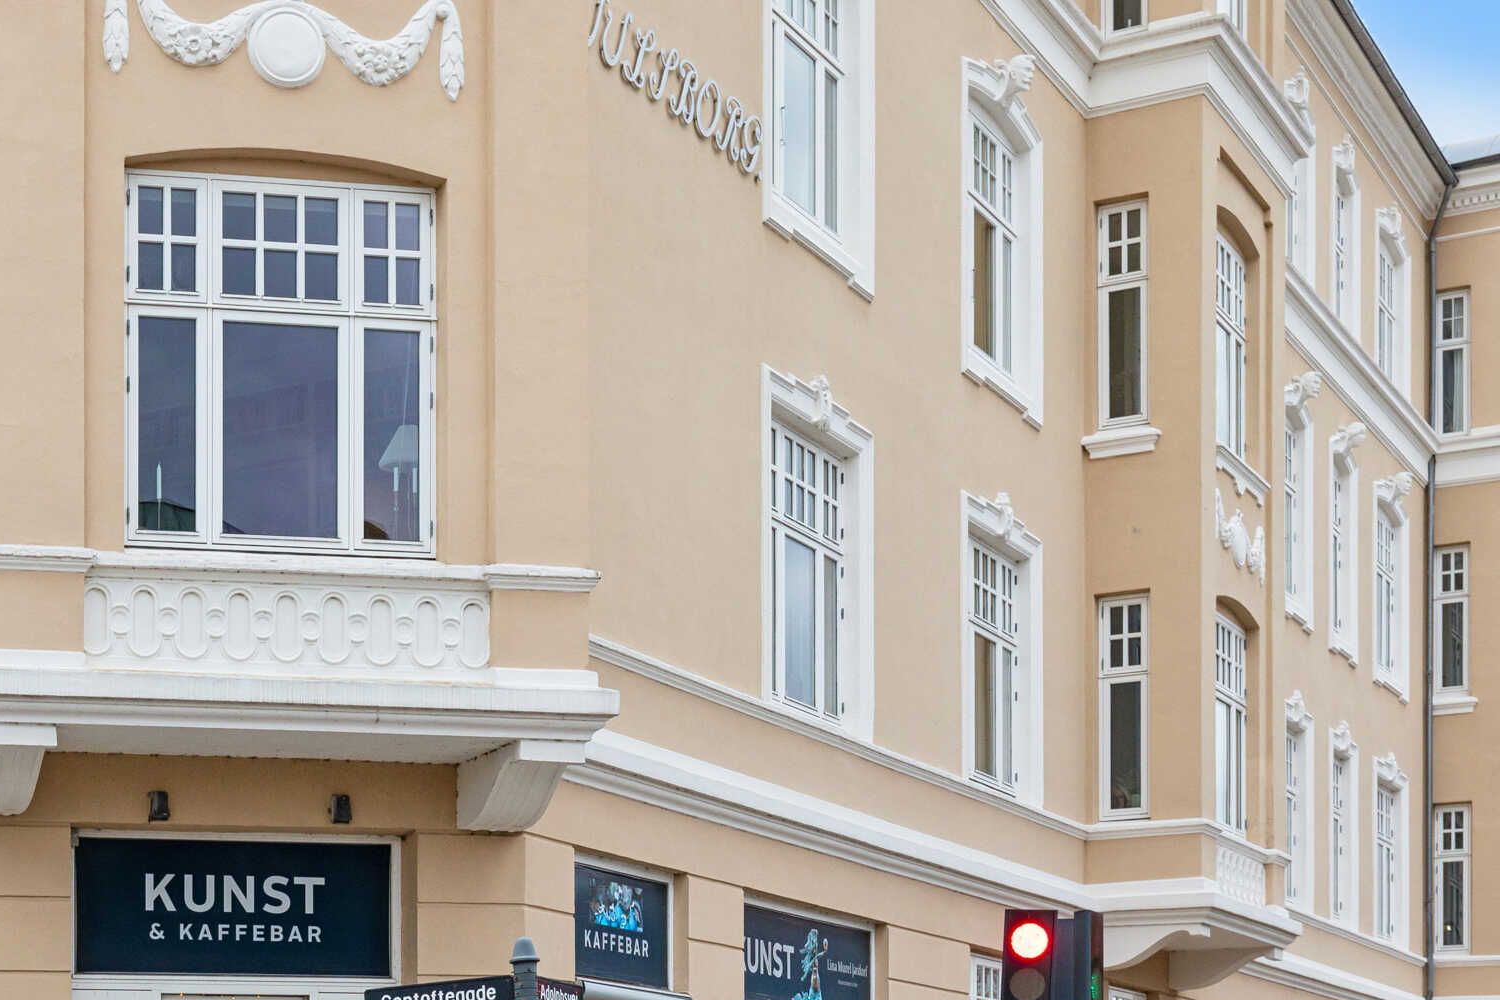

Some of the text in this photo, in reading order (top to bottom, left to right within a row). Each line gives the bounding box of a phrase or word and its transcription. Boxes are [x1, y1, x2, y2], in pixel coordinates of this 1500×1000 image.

[144, 873, 326, 915] KUNST
[149, 923, 322, 943] & KAFFEBAR
[584, 928, 649, 958] KAFFEBAR
[743, 936, 795, 980] UNST
